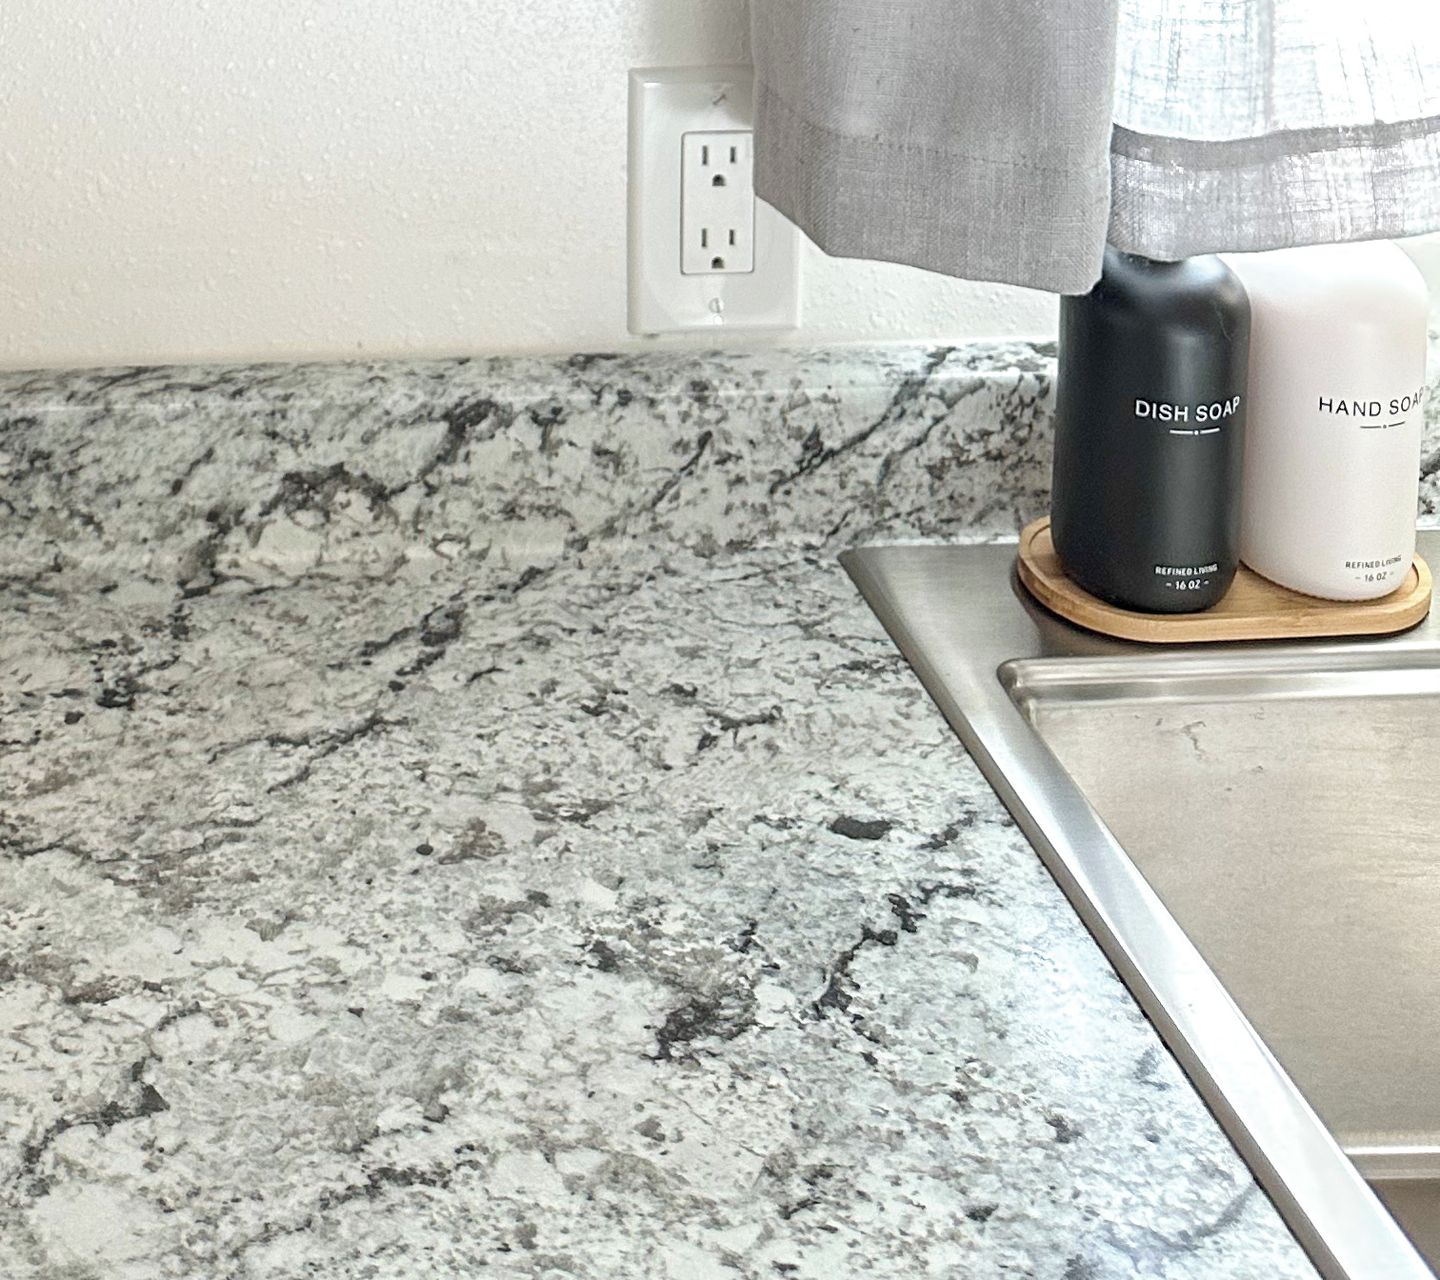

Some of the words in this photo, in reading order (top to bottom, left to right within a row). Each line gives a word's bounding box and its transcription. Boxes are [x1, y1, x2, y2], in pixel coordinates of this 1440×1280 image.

[1135, 398, 1189, 422] DISH
[1195, 395, 1241, 422] SOAP
[1319, 396, 1382, 417] HAND
[1345, 560, 1380, 570] REFINED
[1155, 565, 1192, 576] REFINED
[1364, 574, 1375, 582] 16
[1175, 581, 1187, 590] 16
